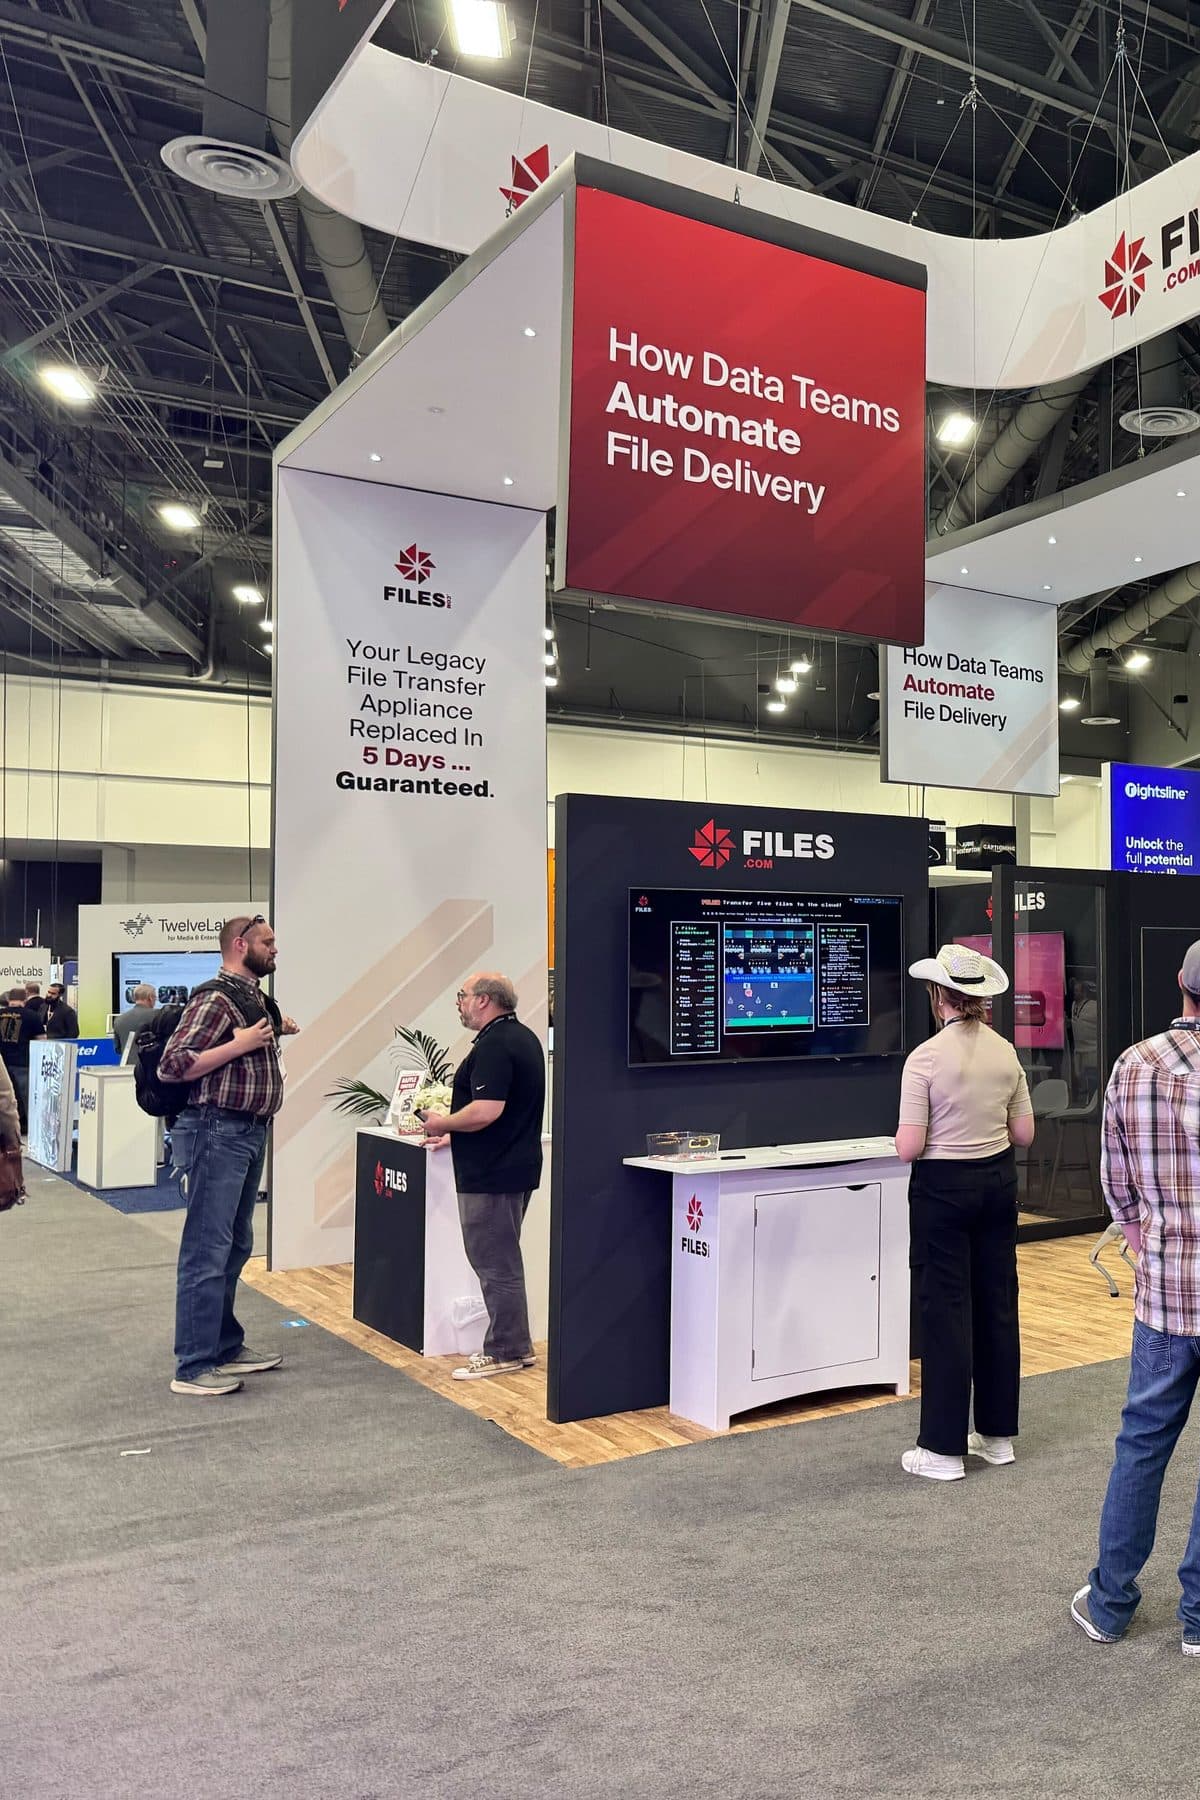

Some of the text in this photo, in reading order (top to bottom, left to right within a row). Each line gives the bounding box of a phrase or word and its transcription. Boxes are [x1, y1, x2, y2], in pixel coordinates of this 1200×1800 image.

[1163, 260, 1200, 292] .COM
[608, 327, 900, 432] How Data Teams
[605, 381, 801, 455] Automate
[607, 431, 826, 514] File Delivery
[384, 586, 446, 608] FILES
[346, 638, 486, 674] Your Legacy
[903, 647, 1044, 684] How Data Teams
[347, 666, 486, 696] File Transfer
[902, 674, 995, 701] Automate
[359, 694, 473, 720] Appliance
[904, 701, 1007, 732] File Delivery
[350, 719, 483, 747] Replaced In
[363, 747, 378, 765] 5
[385, 748, 446, 772] Days
[335, 770, 494, 798] Guaranteed.
[743, 830, 835, 860] FILES
[1125, 836, 1184, 851] Unlock the
[743, 858, 773, 869] .COM
[1125, 851, 1193, 867] full potential
[1014, 892, 1046, 912] ILES
[158, 918, 226, 932] TwelveLa
[0, 965, 43, 977] elveLabs
[77, 1045, 98, 1056] tel
[385, 1167, 408, 1193] FILES
[681, 1236, 707, 1257] FILES
